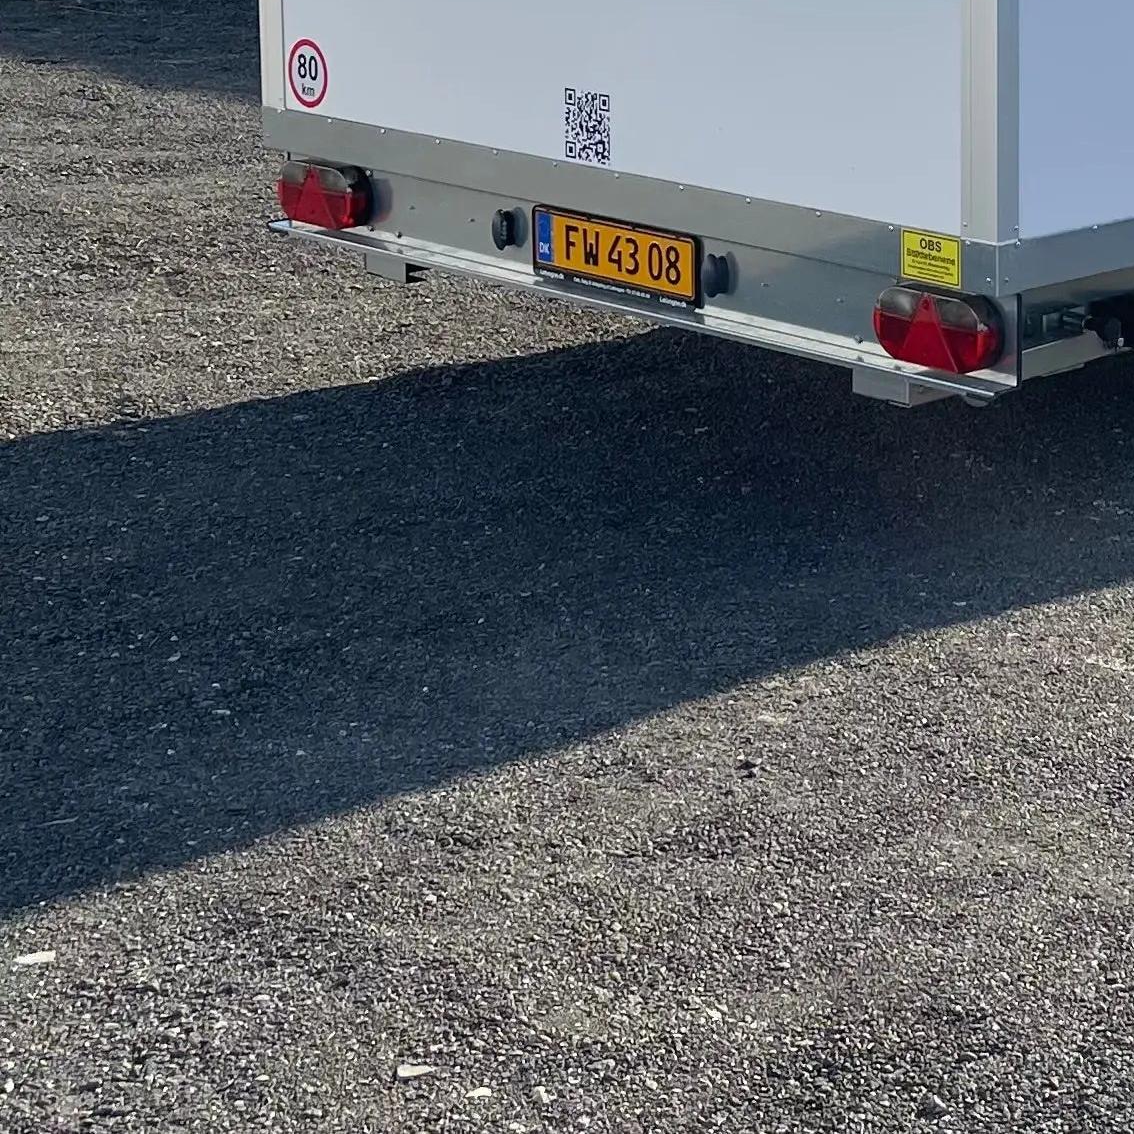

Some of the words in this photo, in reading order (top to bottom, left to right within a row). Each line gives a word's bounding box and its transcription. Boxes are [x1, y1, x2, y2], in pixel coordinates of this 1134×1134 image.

[298, 54, 318, 81] 80
[539, 242, 550, 254] DK
[565, 225, 599, 266] FW
[608, 235, 640, 275] 43
[648, 242, 681, 285] 08
[920, 238, 942, 253] OBS
